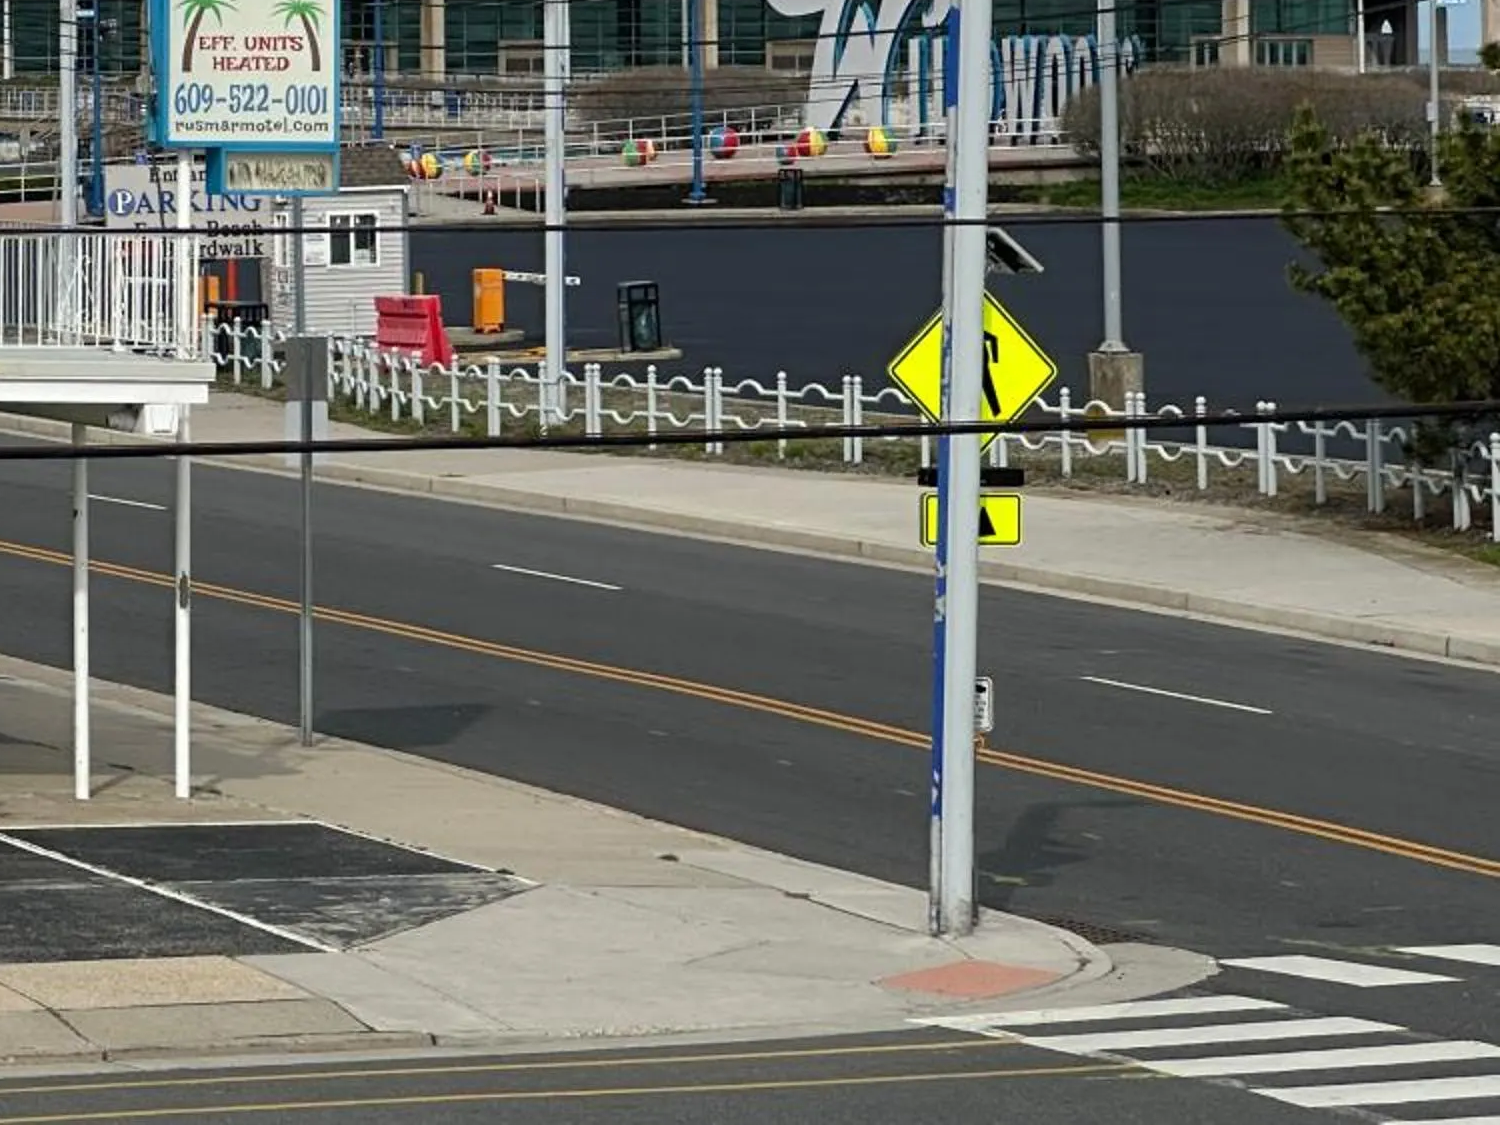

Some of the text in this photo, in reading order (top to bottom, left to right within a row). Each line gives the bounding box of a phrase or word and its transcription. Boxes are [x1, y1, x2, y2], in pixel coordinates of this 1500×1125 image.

[199, 36, 303, 51] EFF. UNITS
[213, 56, 290, 72] HEATED
[175, 83, 328, 115] 609-522-0101
